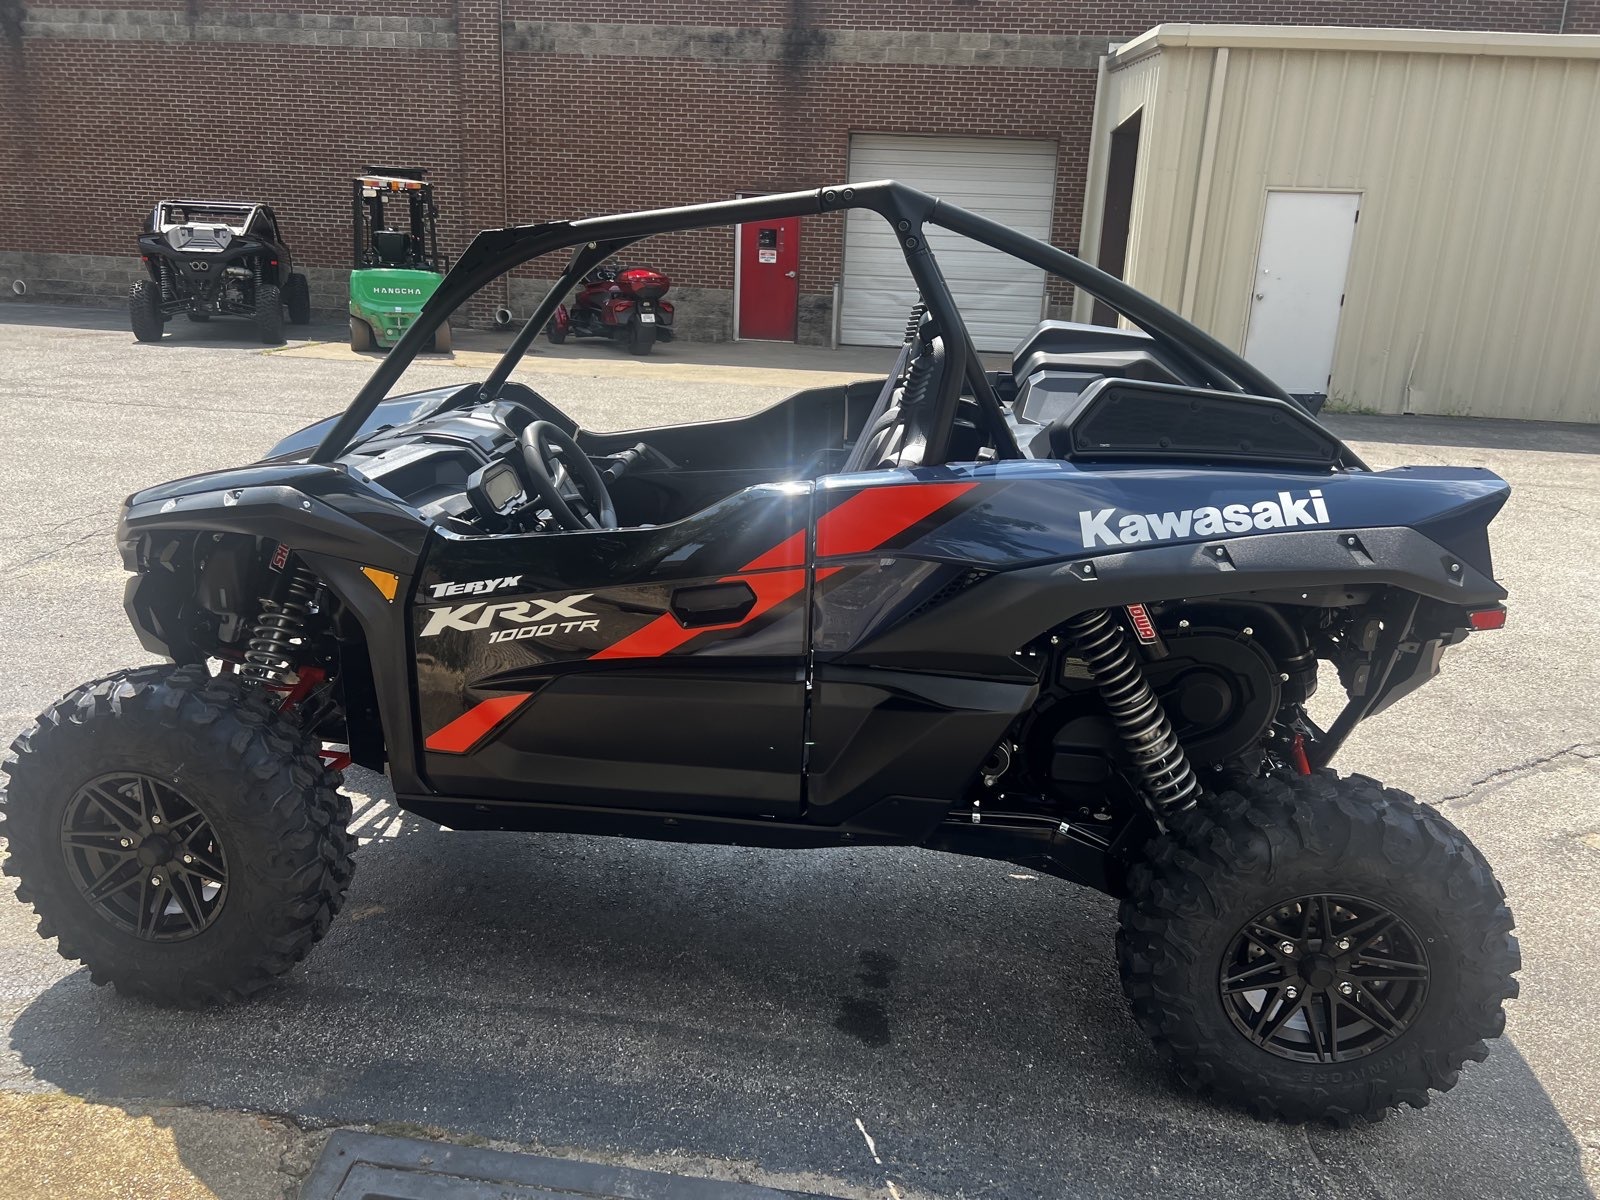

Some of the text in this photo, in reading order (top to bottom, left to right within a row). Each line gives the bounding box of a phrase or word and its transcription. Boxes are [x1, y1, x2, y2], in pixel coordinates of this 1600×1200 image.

[373, 287, 422, 295] HANGCHA
[1078, 489, 1330, 548] Kawasaki
[273, 543, 290, 569] SH
[429, 574, 523, 598] TERYX
[419, 593, 598, 637] KRX
[1127, 603, 1156, 639] OWA
